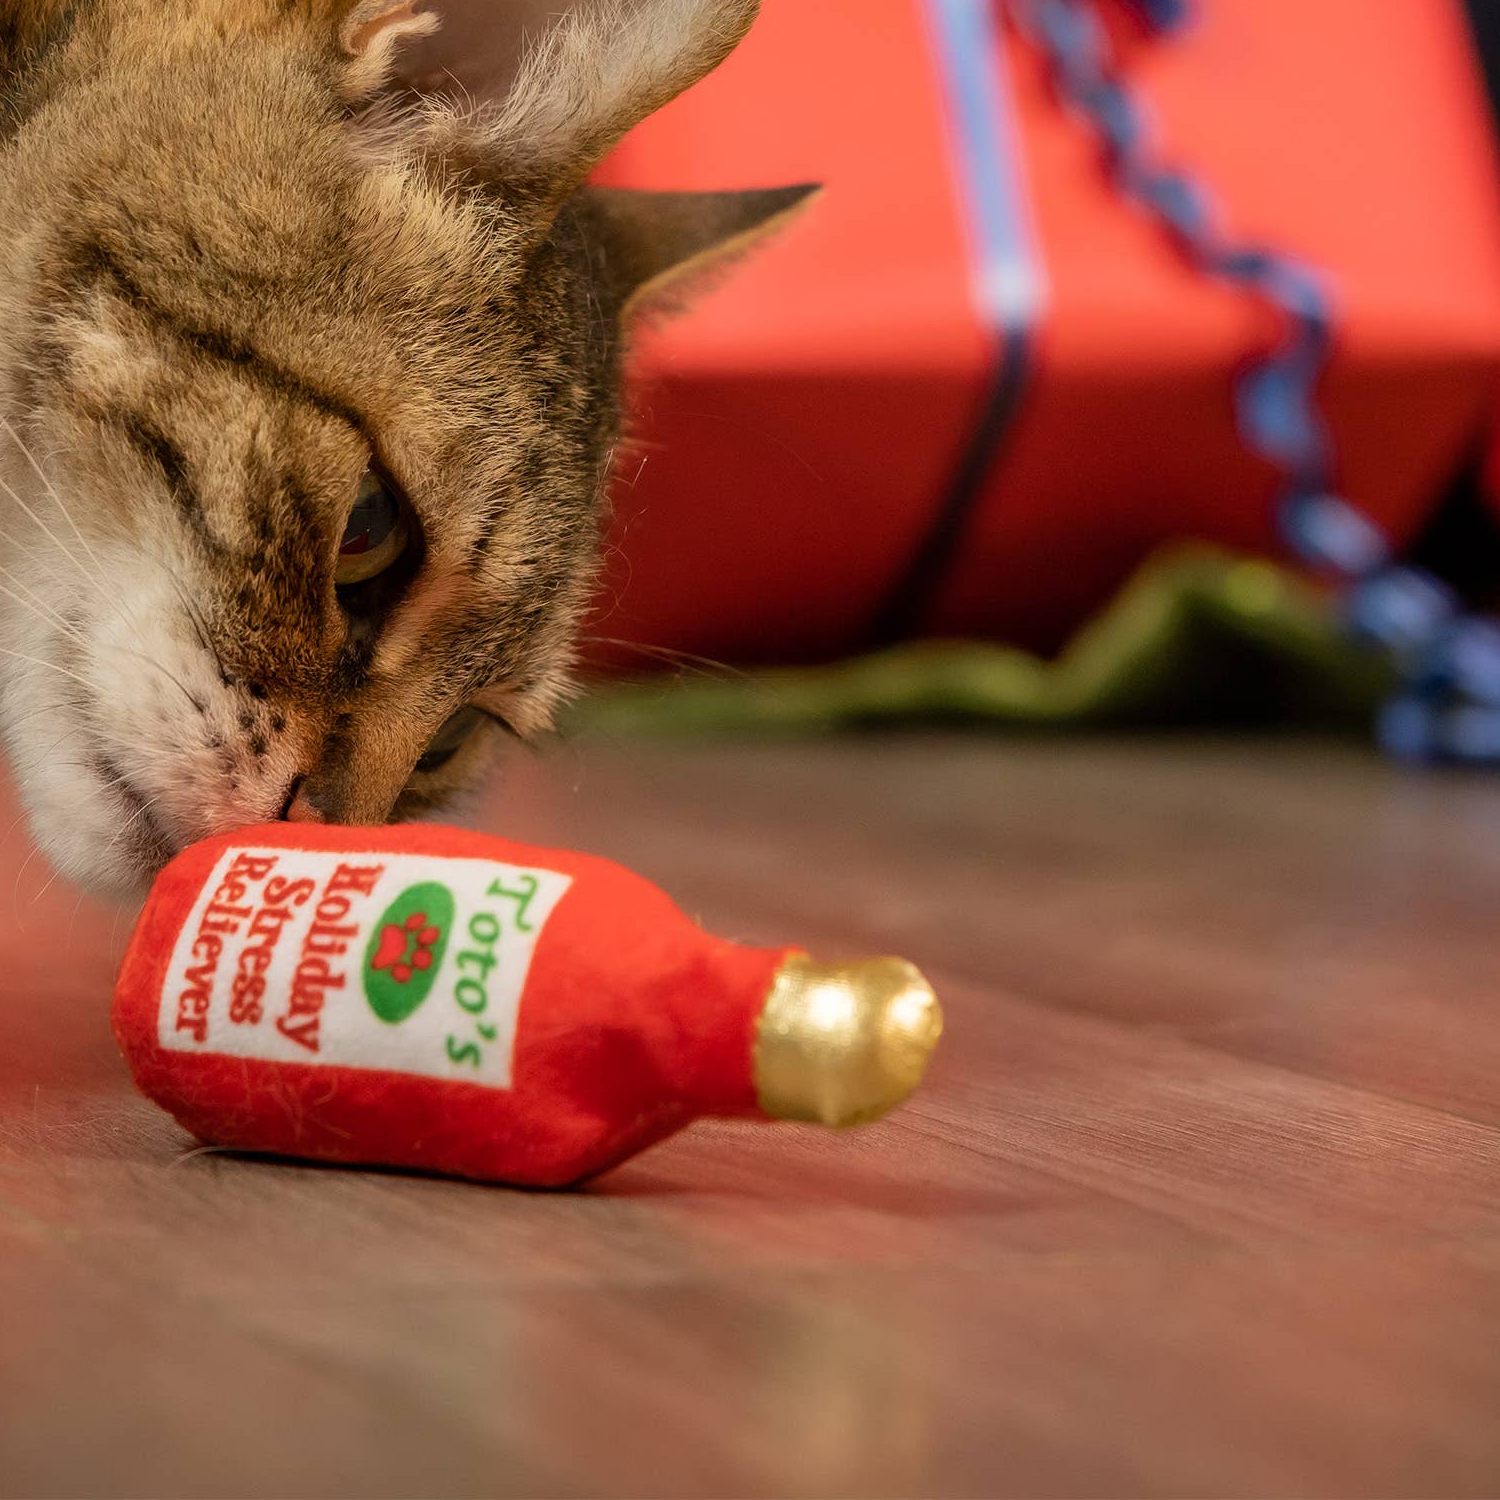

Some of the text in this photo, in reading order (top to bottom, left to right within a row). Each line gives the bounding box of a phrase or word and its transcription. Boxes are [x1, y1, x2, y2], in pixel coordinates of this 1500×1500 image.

[175, 852, 279, 1042] Reliever
[229, 876, 315, 1026] Stress
[276, 863, 385, 1053] Holiday
[446, 874, 538, 1069] Toto's
